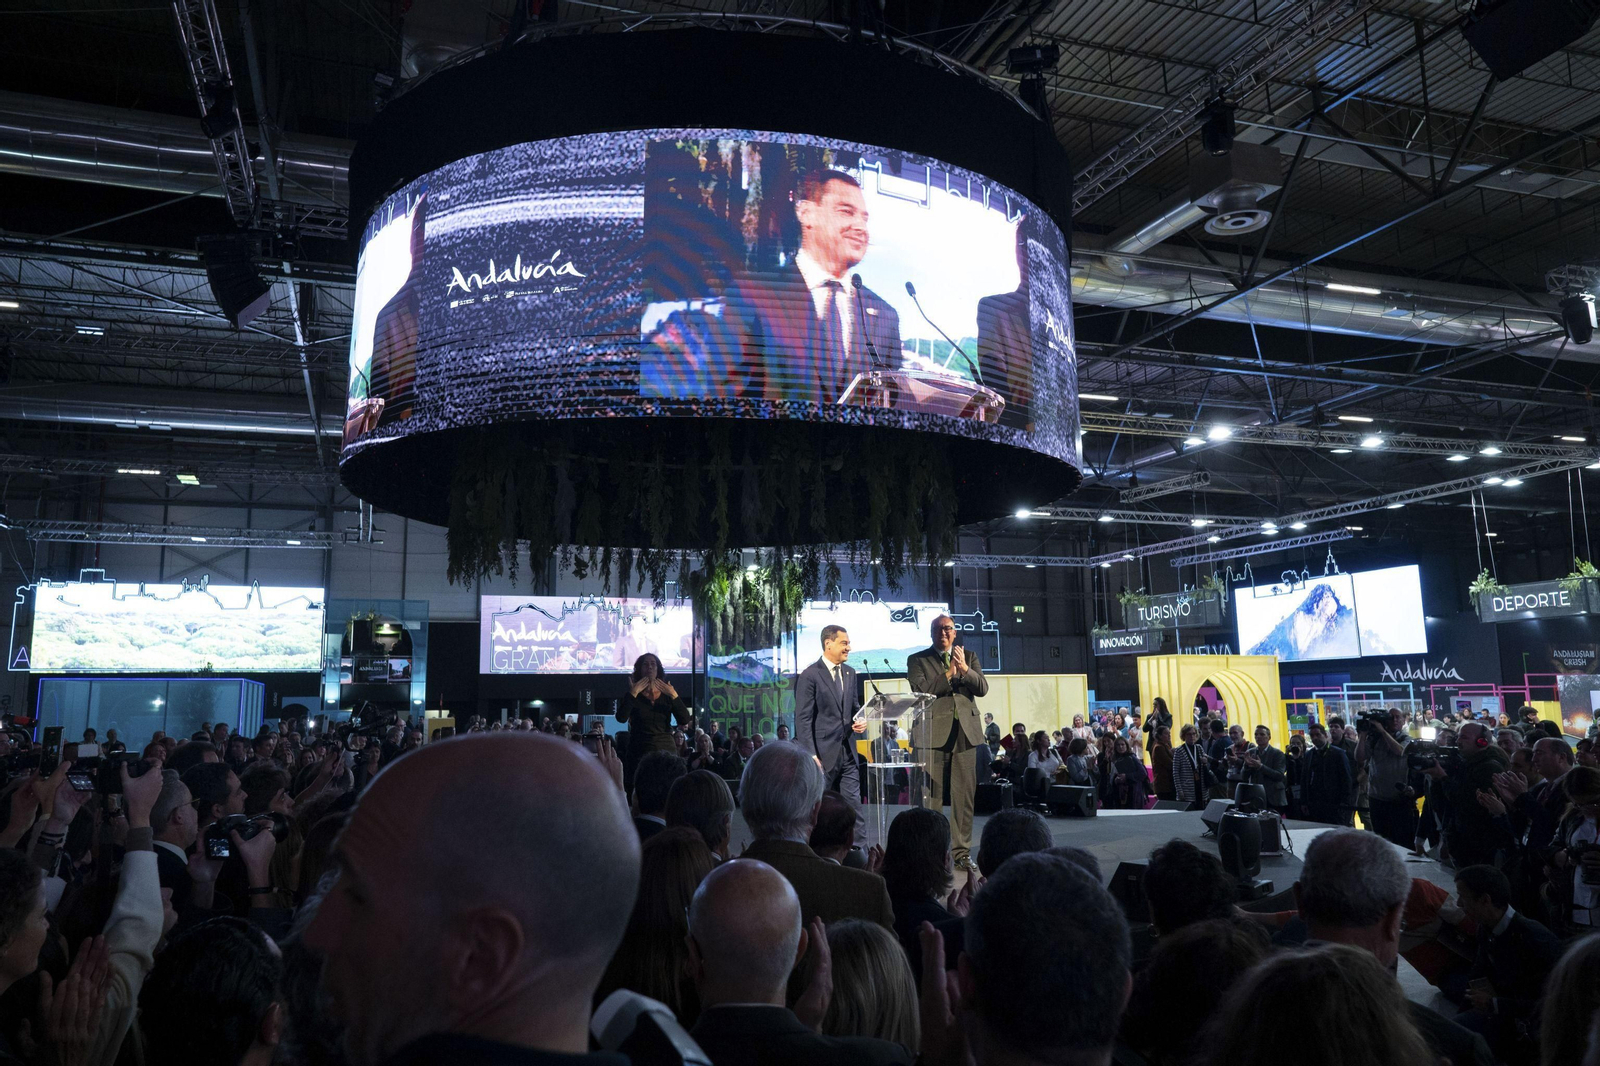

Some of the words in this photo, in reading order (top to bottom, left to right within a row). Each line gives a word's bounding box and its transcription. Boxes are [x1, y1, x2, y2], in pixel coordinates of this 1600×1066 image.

[445, 249, 586, 296] Andalucía
[1138, 602, 1191, 621] TURISMO
[1493, 590, 1570, 612] DEPORTE
[491, 621, 579, 643] Andalucía
[1100, 632, 1143, 649] INNOVACIÓN
[12, 646, 32, 668] A
[710, 668, 790, 688] DIGAS
[1380, 657, 1465, 682] Andalucía
[709, 694, 756, 714] QUE
[762, 692, 796, 713] NO
